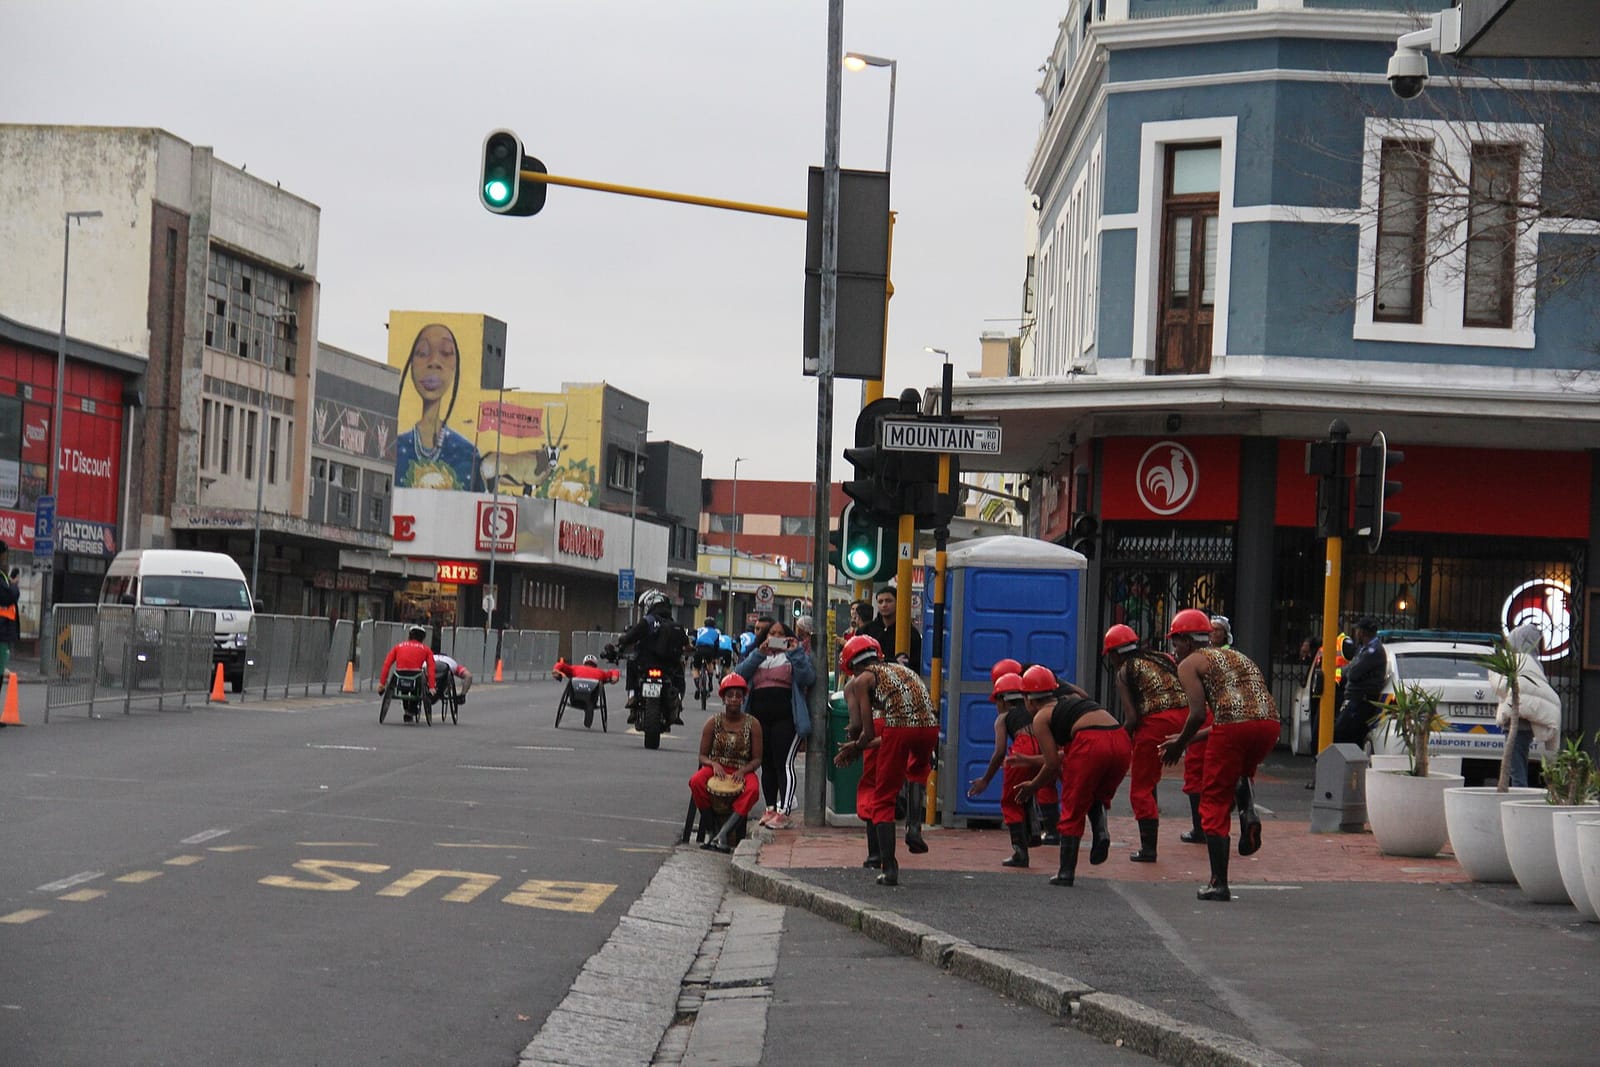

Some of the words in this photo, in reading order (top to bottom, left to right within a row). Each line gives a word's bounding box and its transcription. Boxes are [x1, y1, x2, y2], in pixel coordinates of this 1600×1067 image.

[891, 426, 974, 449] MOUNTAIN
[987, 431, 997, 439] RD
[981, 441, 996, 450] WEG
[72, 450, 111, 478] Discount
[39, 518, 47, 535] R
[63, 522, 104, 541] ALTONA
[63, 538, 104, 555] FISHERIES
[902, 546, 908, 557] 4
[257, 858, 618, 913] BUS
